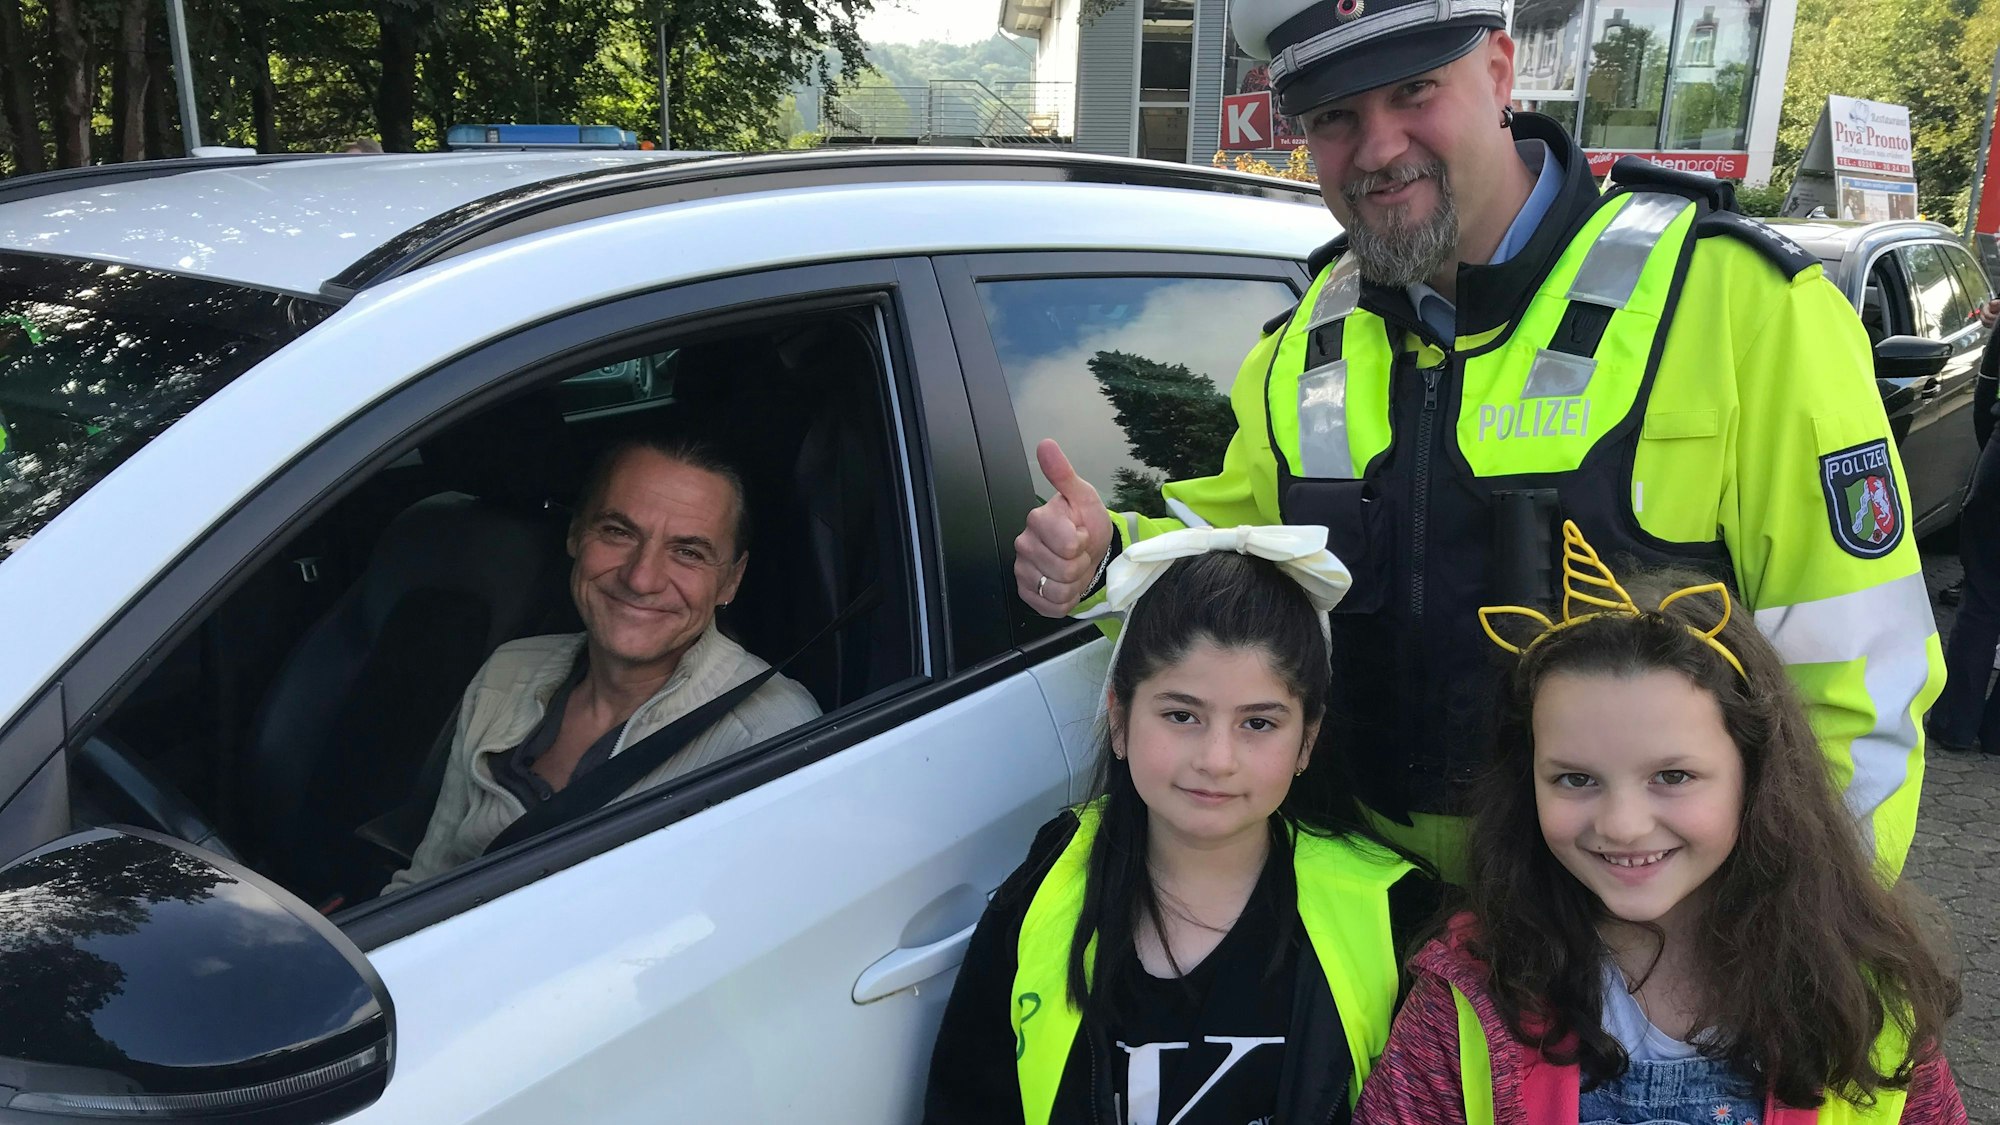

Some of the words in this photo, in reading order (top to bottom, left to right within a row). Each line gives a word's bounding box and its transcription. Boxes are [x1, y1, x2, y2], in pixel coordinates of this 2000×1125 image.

[1228, 101, 1263, 144] K
[1871, 112, 1907, 127] Restaurant
[1835, 121, 1863, 147] Piya
[1866, 126, 1908, 151] Pronto
[1478, 398, 1591, 442] POLIZEI
[1829, 449, 1887, 479] POLIZEI
